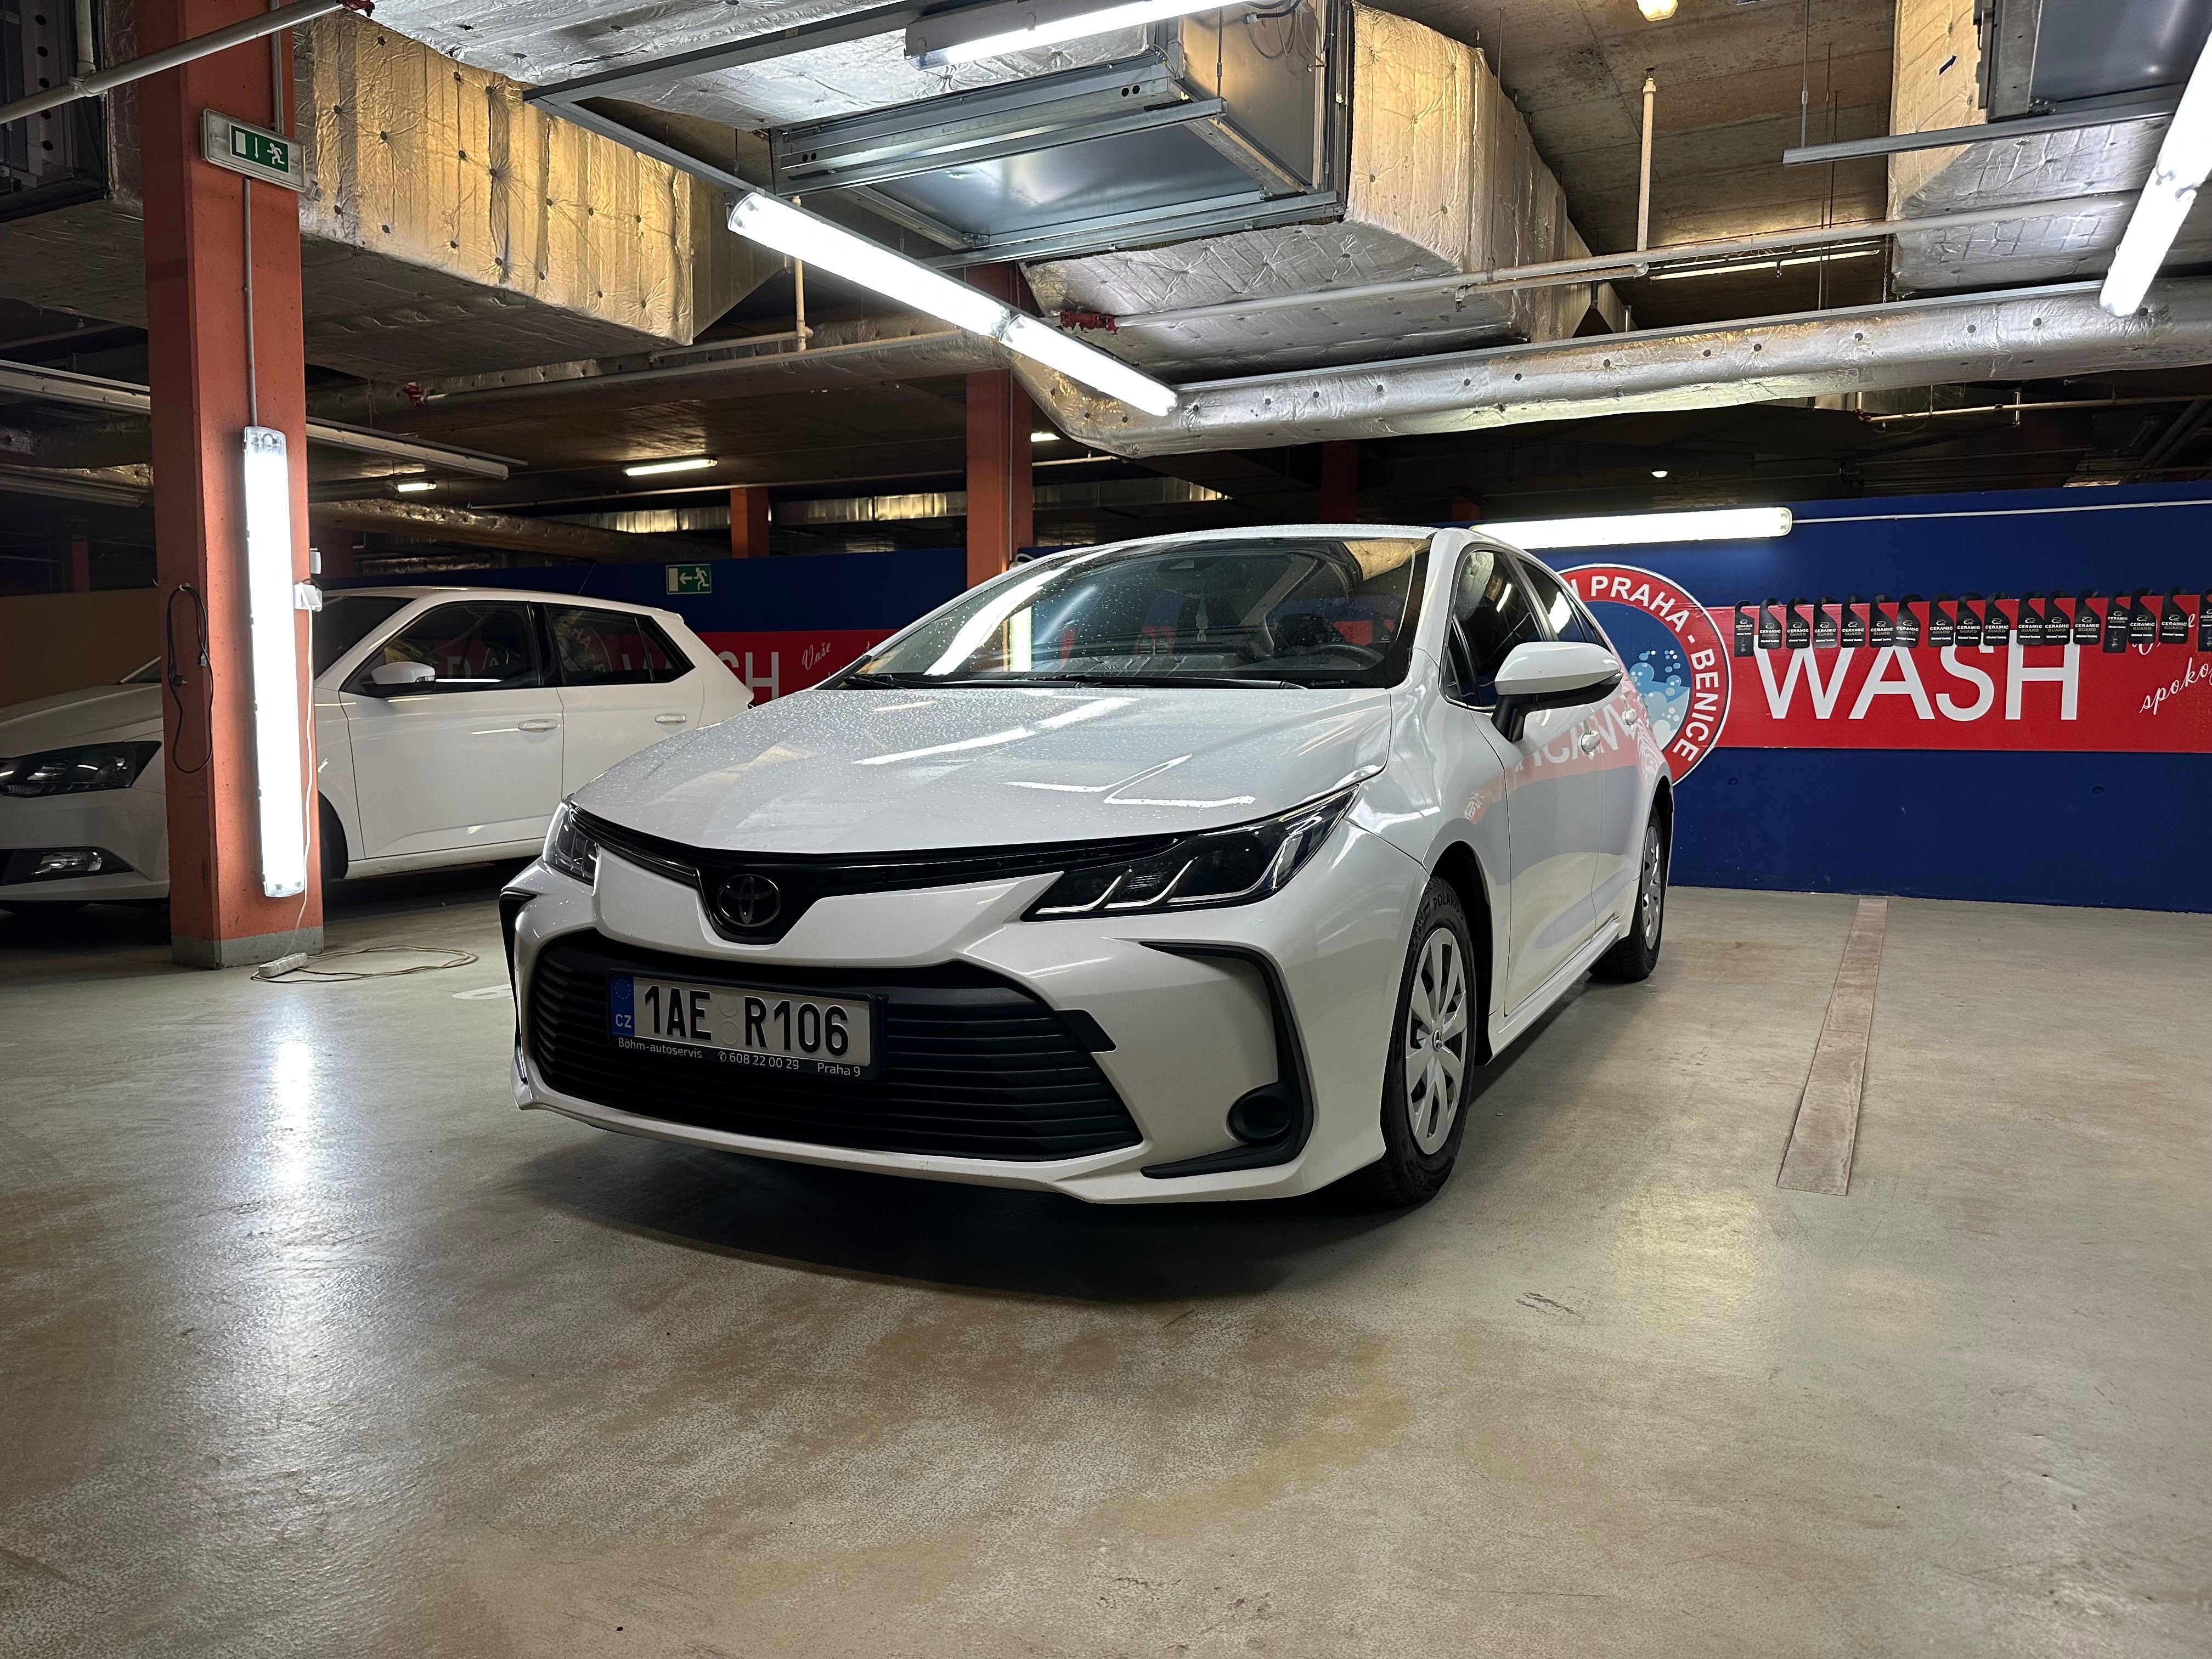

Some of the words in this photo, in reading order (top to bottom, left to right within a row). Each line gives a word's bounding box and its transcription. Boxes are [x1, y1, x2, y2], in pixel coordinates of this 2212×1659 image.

[802, 641, 831, 671] Vaše
[1591, 575, 1690, 633] PRAHA
[1672, 648, 1719, 762] BENICE
[1753, 629, 2079, 721] WASH
[2138, 657, 2212, 715] spoko
[615, 1013, 632, 1029] CZ
[644, 985, 712, 1041] 1AE
[744, 995, 849, 1057] R106
[618, 1037, 703, 1059] Böhm-autoservis
[730, 1052, 750, 1064] 608
[752, 1055, 766, 1066] 22
[769, 1057, 783, 1068] 00
[786, 1058, 799, 1070] 29
[817, 1062, 850, 1076] Praha
[854, 1066, 861, 1077] 9
